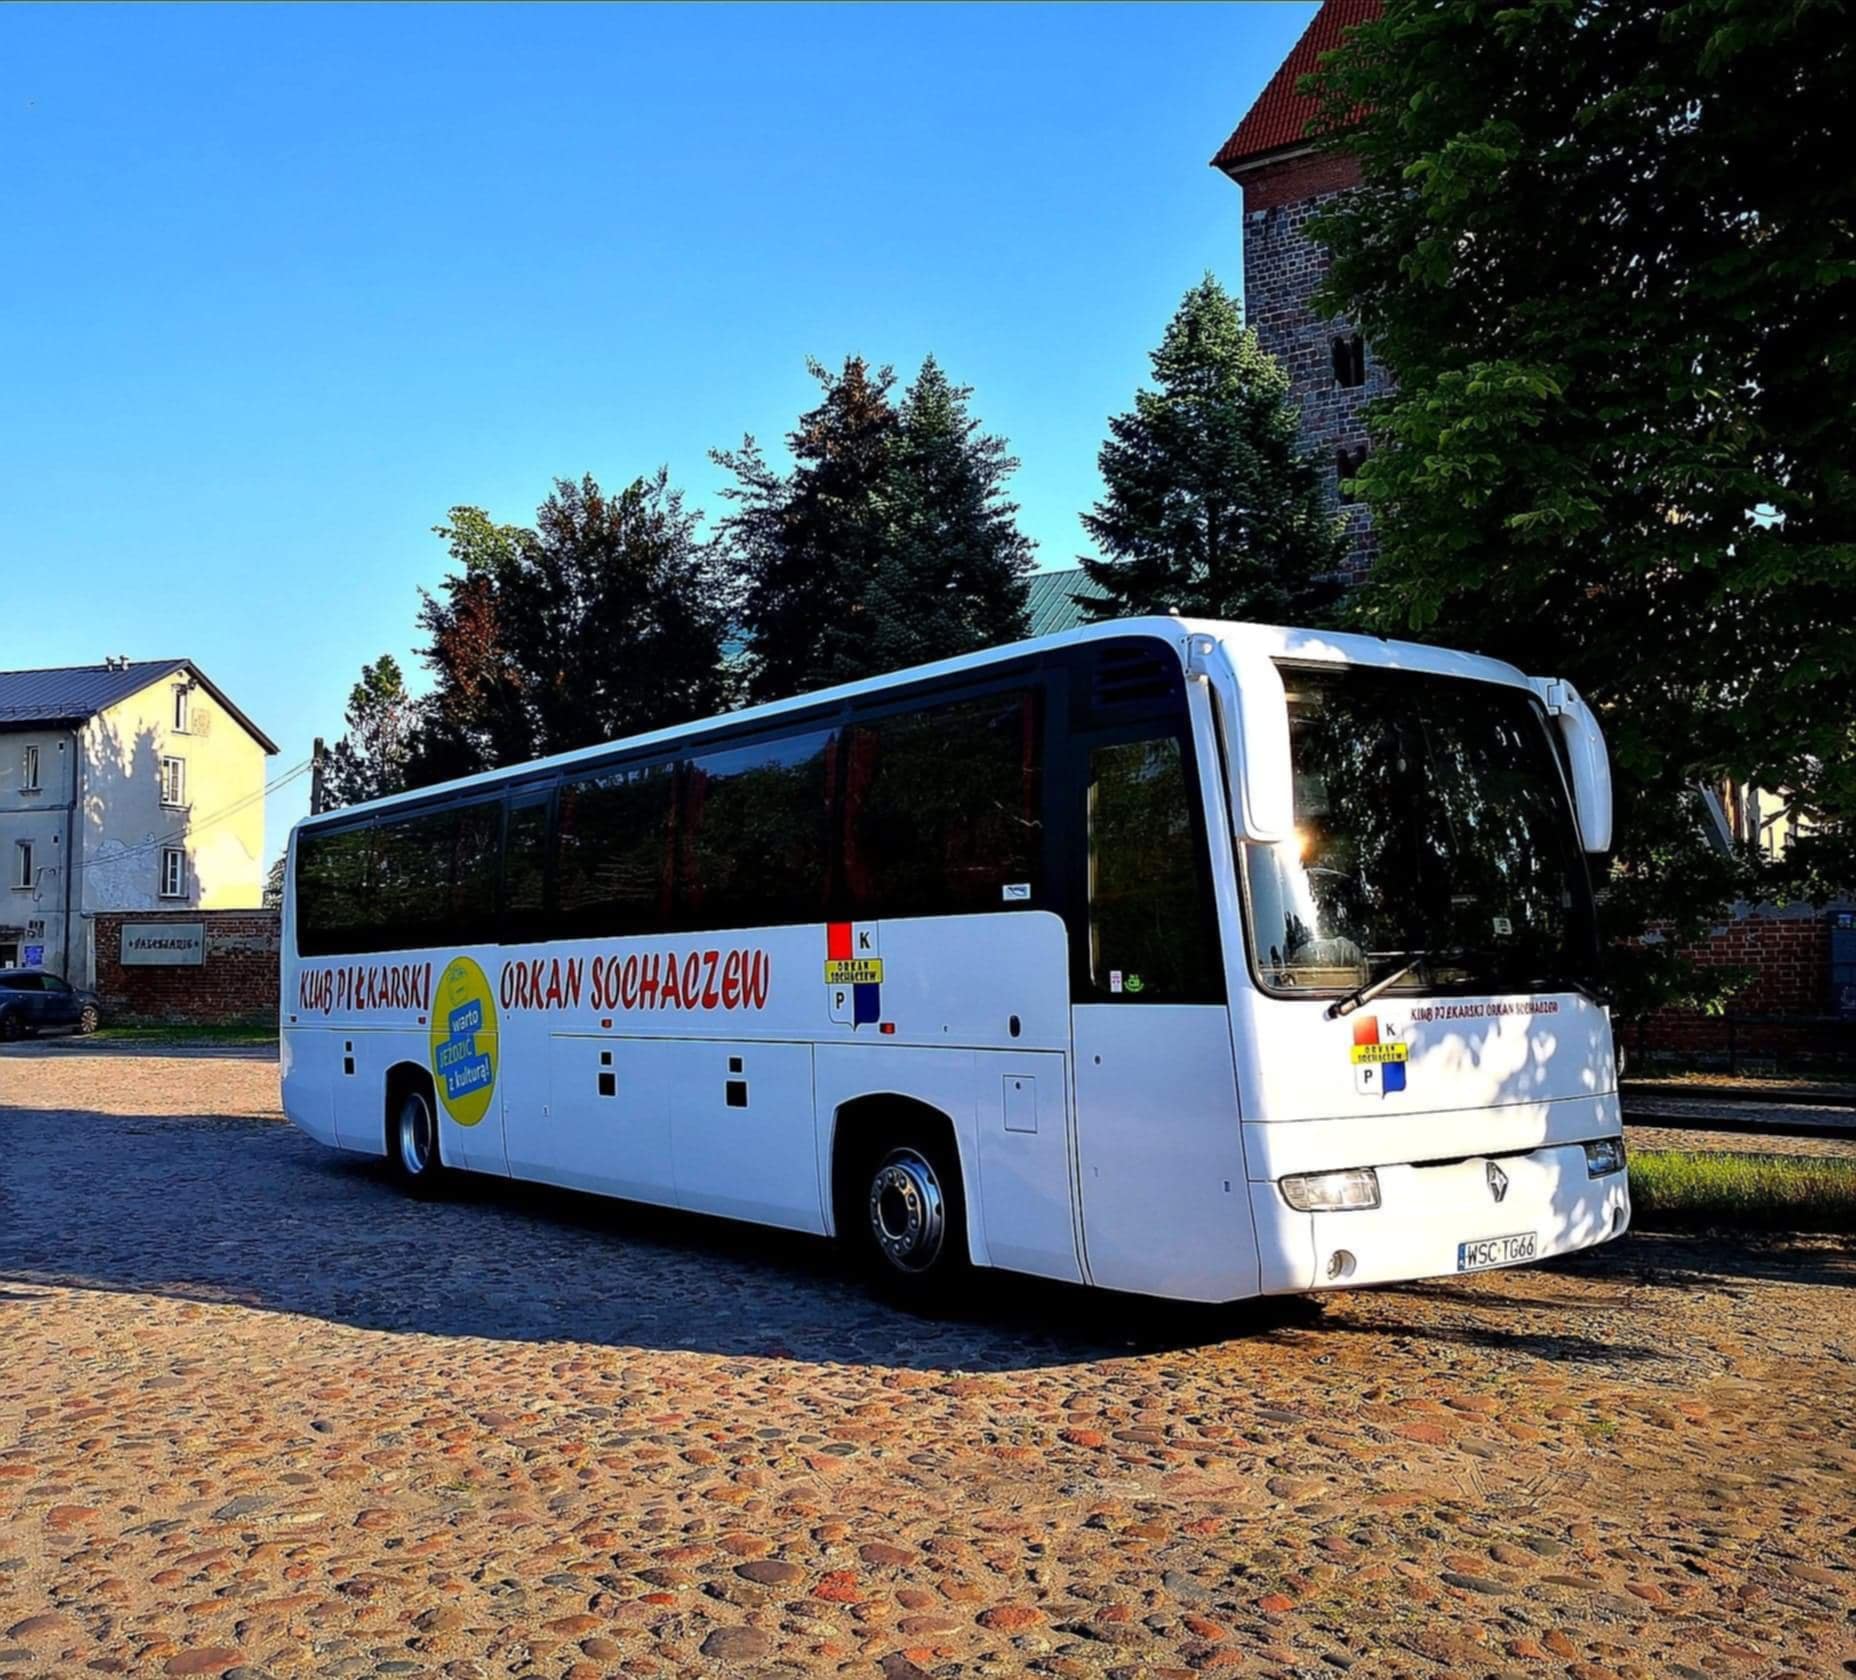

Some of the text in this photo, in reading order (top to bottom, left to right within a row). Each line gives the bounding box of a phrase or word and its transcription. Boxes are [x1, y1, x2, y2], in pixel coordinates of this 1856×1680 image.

[859, 931, 871, 949] K
[299, 949, 770, 1015] KLUB PIŁKARSKI ORKAN SOCHACZEW
[836, 992, 845, 1009] P
[452, 1010, 479, 1032] warto
[1385, 1023, 1396, 1036] K
[1364, 1069, 1373, 1084] P
[1467, 1242, 1498, 1266] WSC
